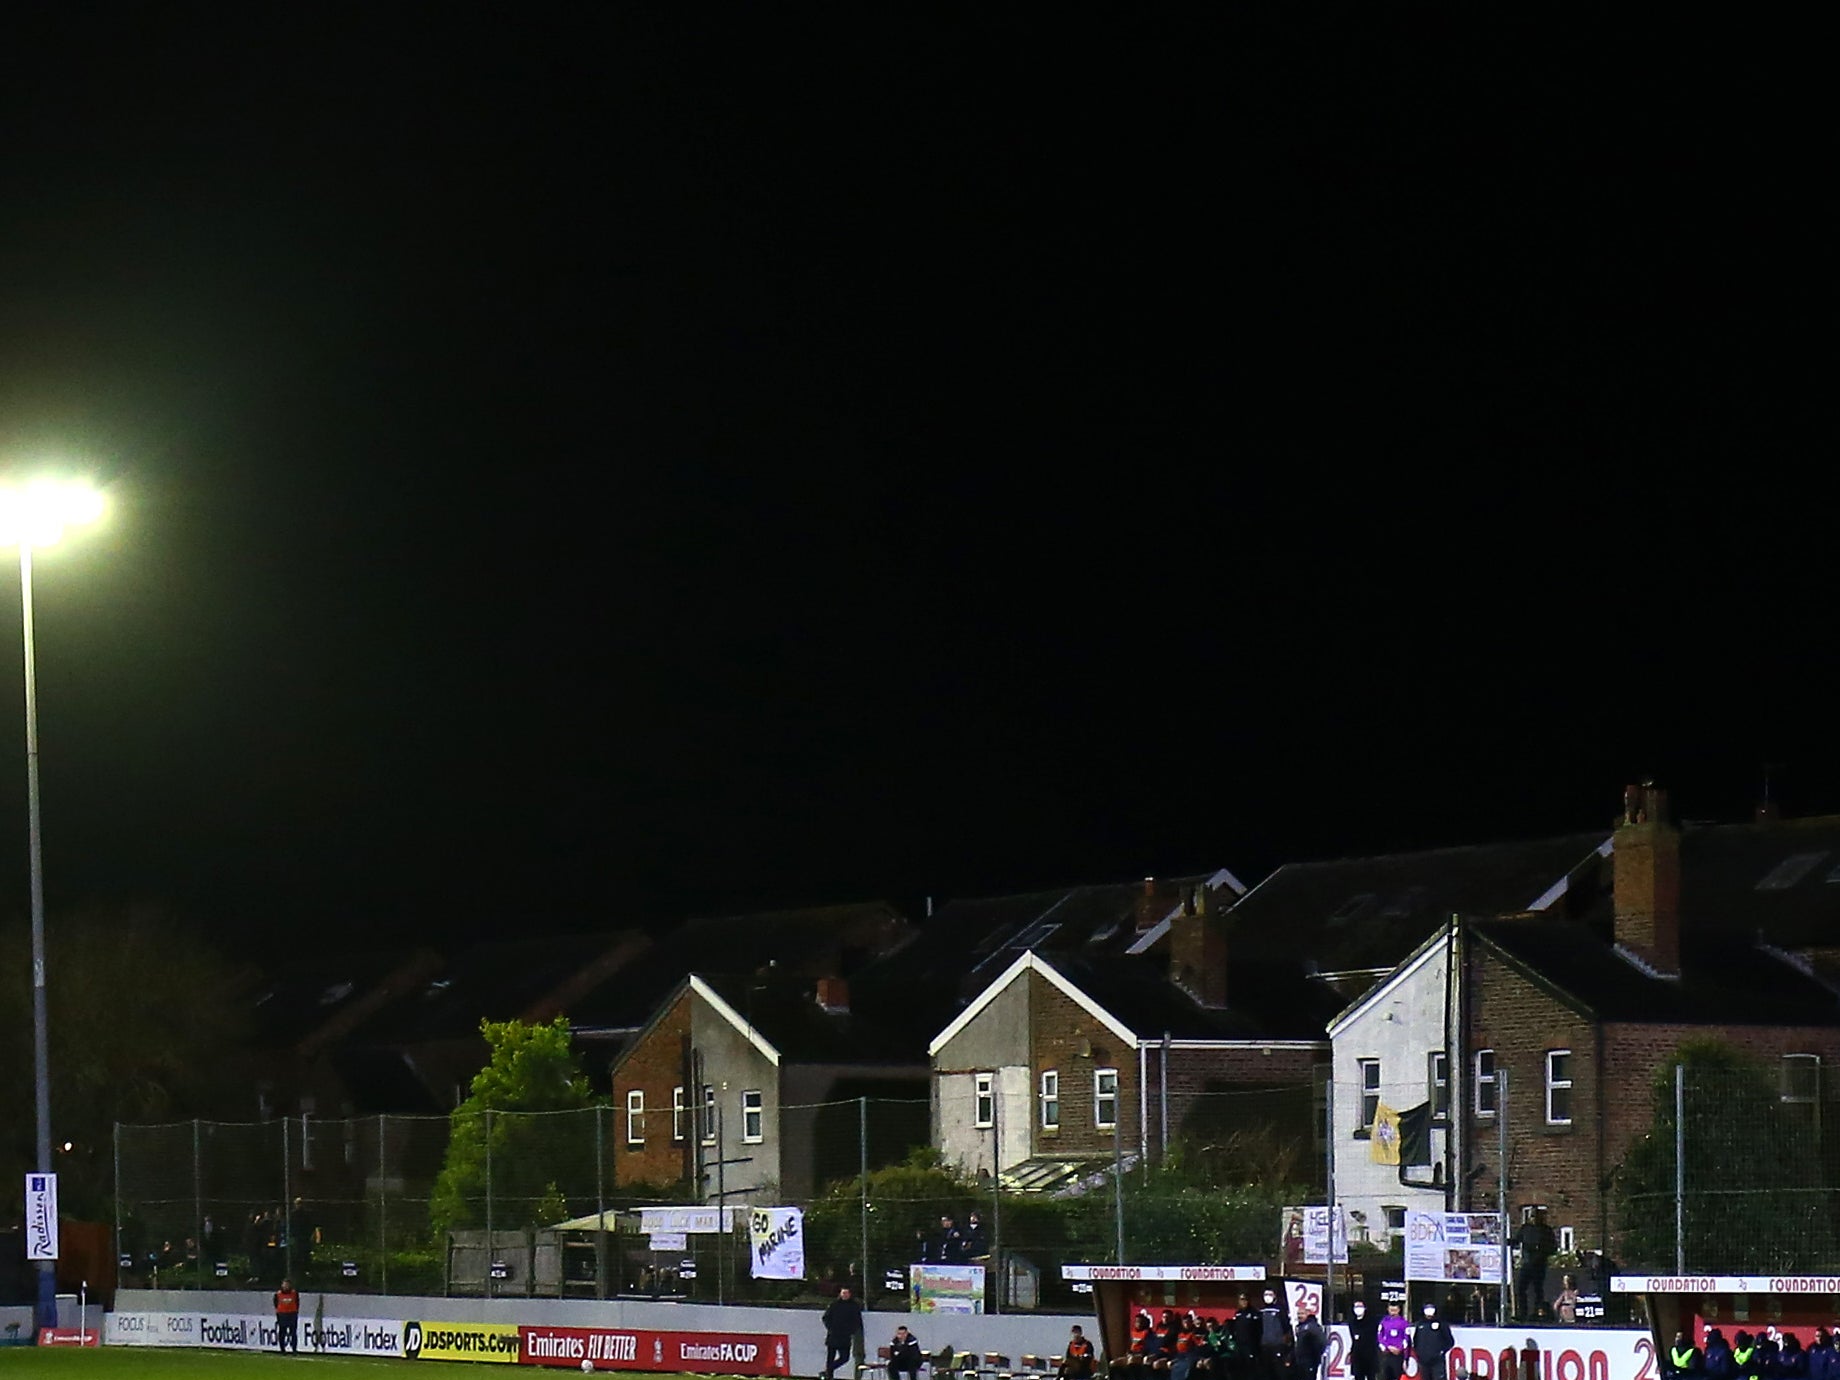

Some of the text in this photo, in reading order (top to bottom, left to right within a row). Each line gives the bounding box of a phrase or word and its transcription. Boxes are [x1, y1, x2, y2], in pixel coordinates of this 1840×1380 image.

[752, 1213, 768, 1233] GO
[757, 1216, 799, 1266] MARINE
[1089, 1268, 1141, 1279] FOUNDATION
[1180, 1268, 1235, 1279] FOUNDATION
[1647, 1279, 1716, 1291] FOUNDATION
[201, 1318, 248, 1344] Football
[304, 1322, 398, 1350] Football Index
[528, 1332, 637, 1361] Emirates FLY BETTER
[680, 1343, 758, 1362] Emirates FA CUP
